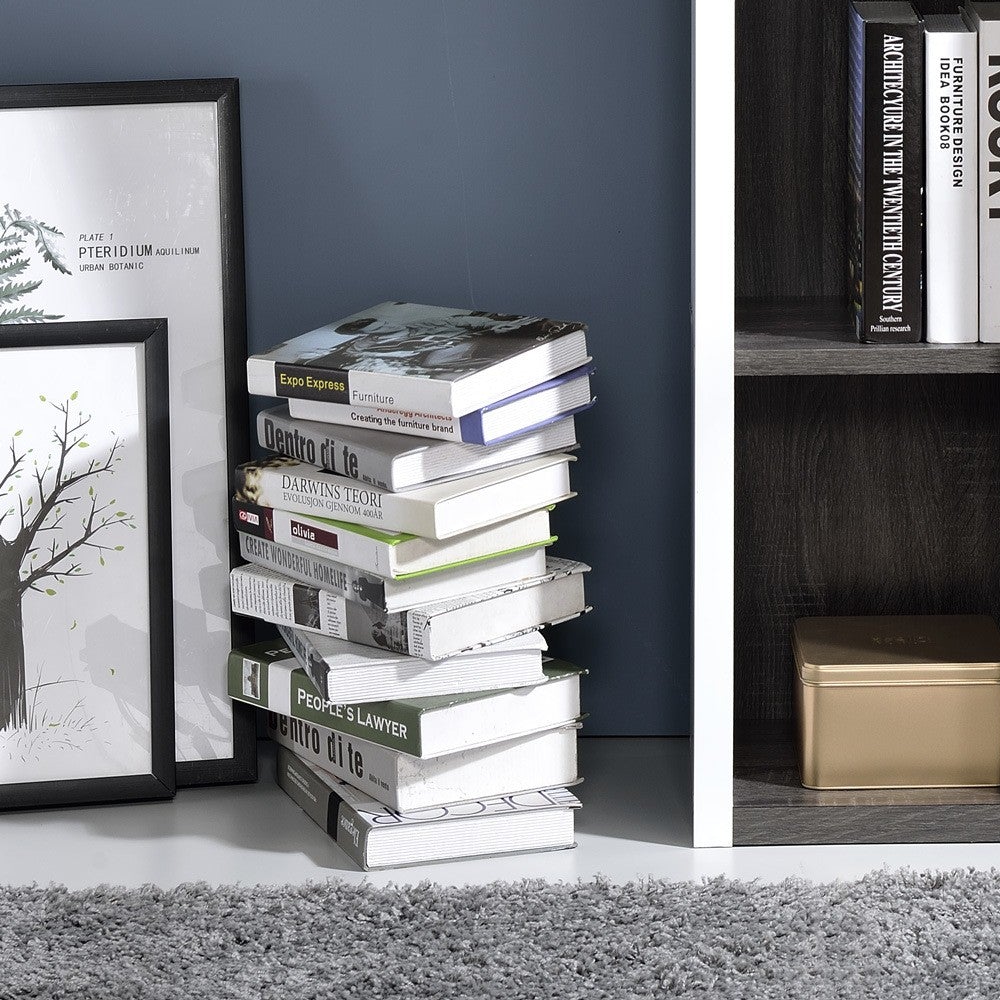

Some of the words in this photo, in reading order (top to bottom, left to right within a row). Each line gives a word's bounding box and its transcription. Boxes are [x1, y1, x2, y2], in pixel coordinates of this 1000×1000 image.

[939, 57, 951, 89] IDEA
[952, 57, 964, 134] FURNITURE
[939, 96, 951, 150] BOOK08
[882, 134, 904, 148] IN
[882, 149, 904, 174] THE
[952, 138, 964, 188] DESIGN
[882, 175, 904, 251] TWENTIETH
[78, 233, 104, 242] PLATE
[110, 233, 114, 241] 1
[78, 244, 153, 258] PTERIDIUM
[155, 247, 200, 256] AQUILINUM
[79, 264, 104, 272] URBAN
[108, 262, 144, 270] BOTANIC
[882, 253, 904, 312] CENTURY
[280, 373, 304, 389] Expo
[306, 374, 345, 391] Express
[352, 390, 394, 405] Furniture
[350, 412, 382, 426] Creating
[384, 416, 396, 426] the
[398, 418, 430, 430] furniture
[432, 423, 454, 434] brand
[264, 418, 316, 464] Dentro
[320, 438, 336, 471] di
[343, 446, 358, 479] te
[282, 474, 340, 500] DARWINS
[344, 487, 383, 508] TEORI
[283, 492, 324, 512] EVOLUSJON
[325, 500, 362, 519] GJENNOM
[292, 524, 316, 541] olivia
[246, 535, 270, 560] CREATE
[270, 546, 312, 576] WONDERFUL
[313, 562, 348, 591] HOMELIFE
[357, 706, 408, 740] LAWYER
[268, 711, 320, 755] Dentro
[327, 732, 343, 768] di
[348, 742, 364, 779] te
